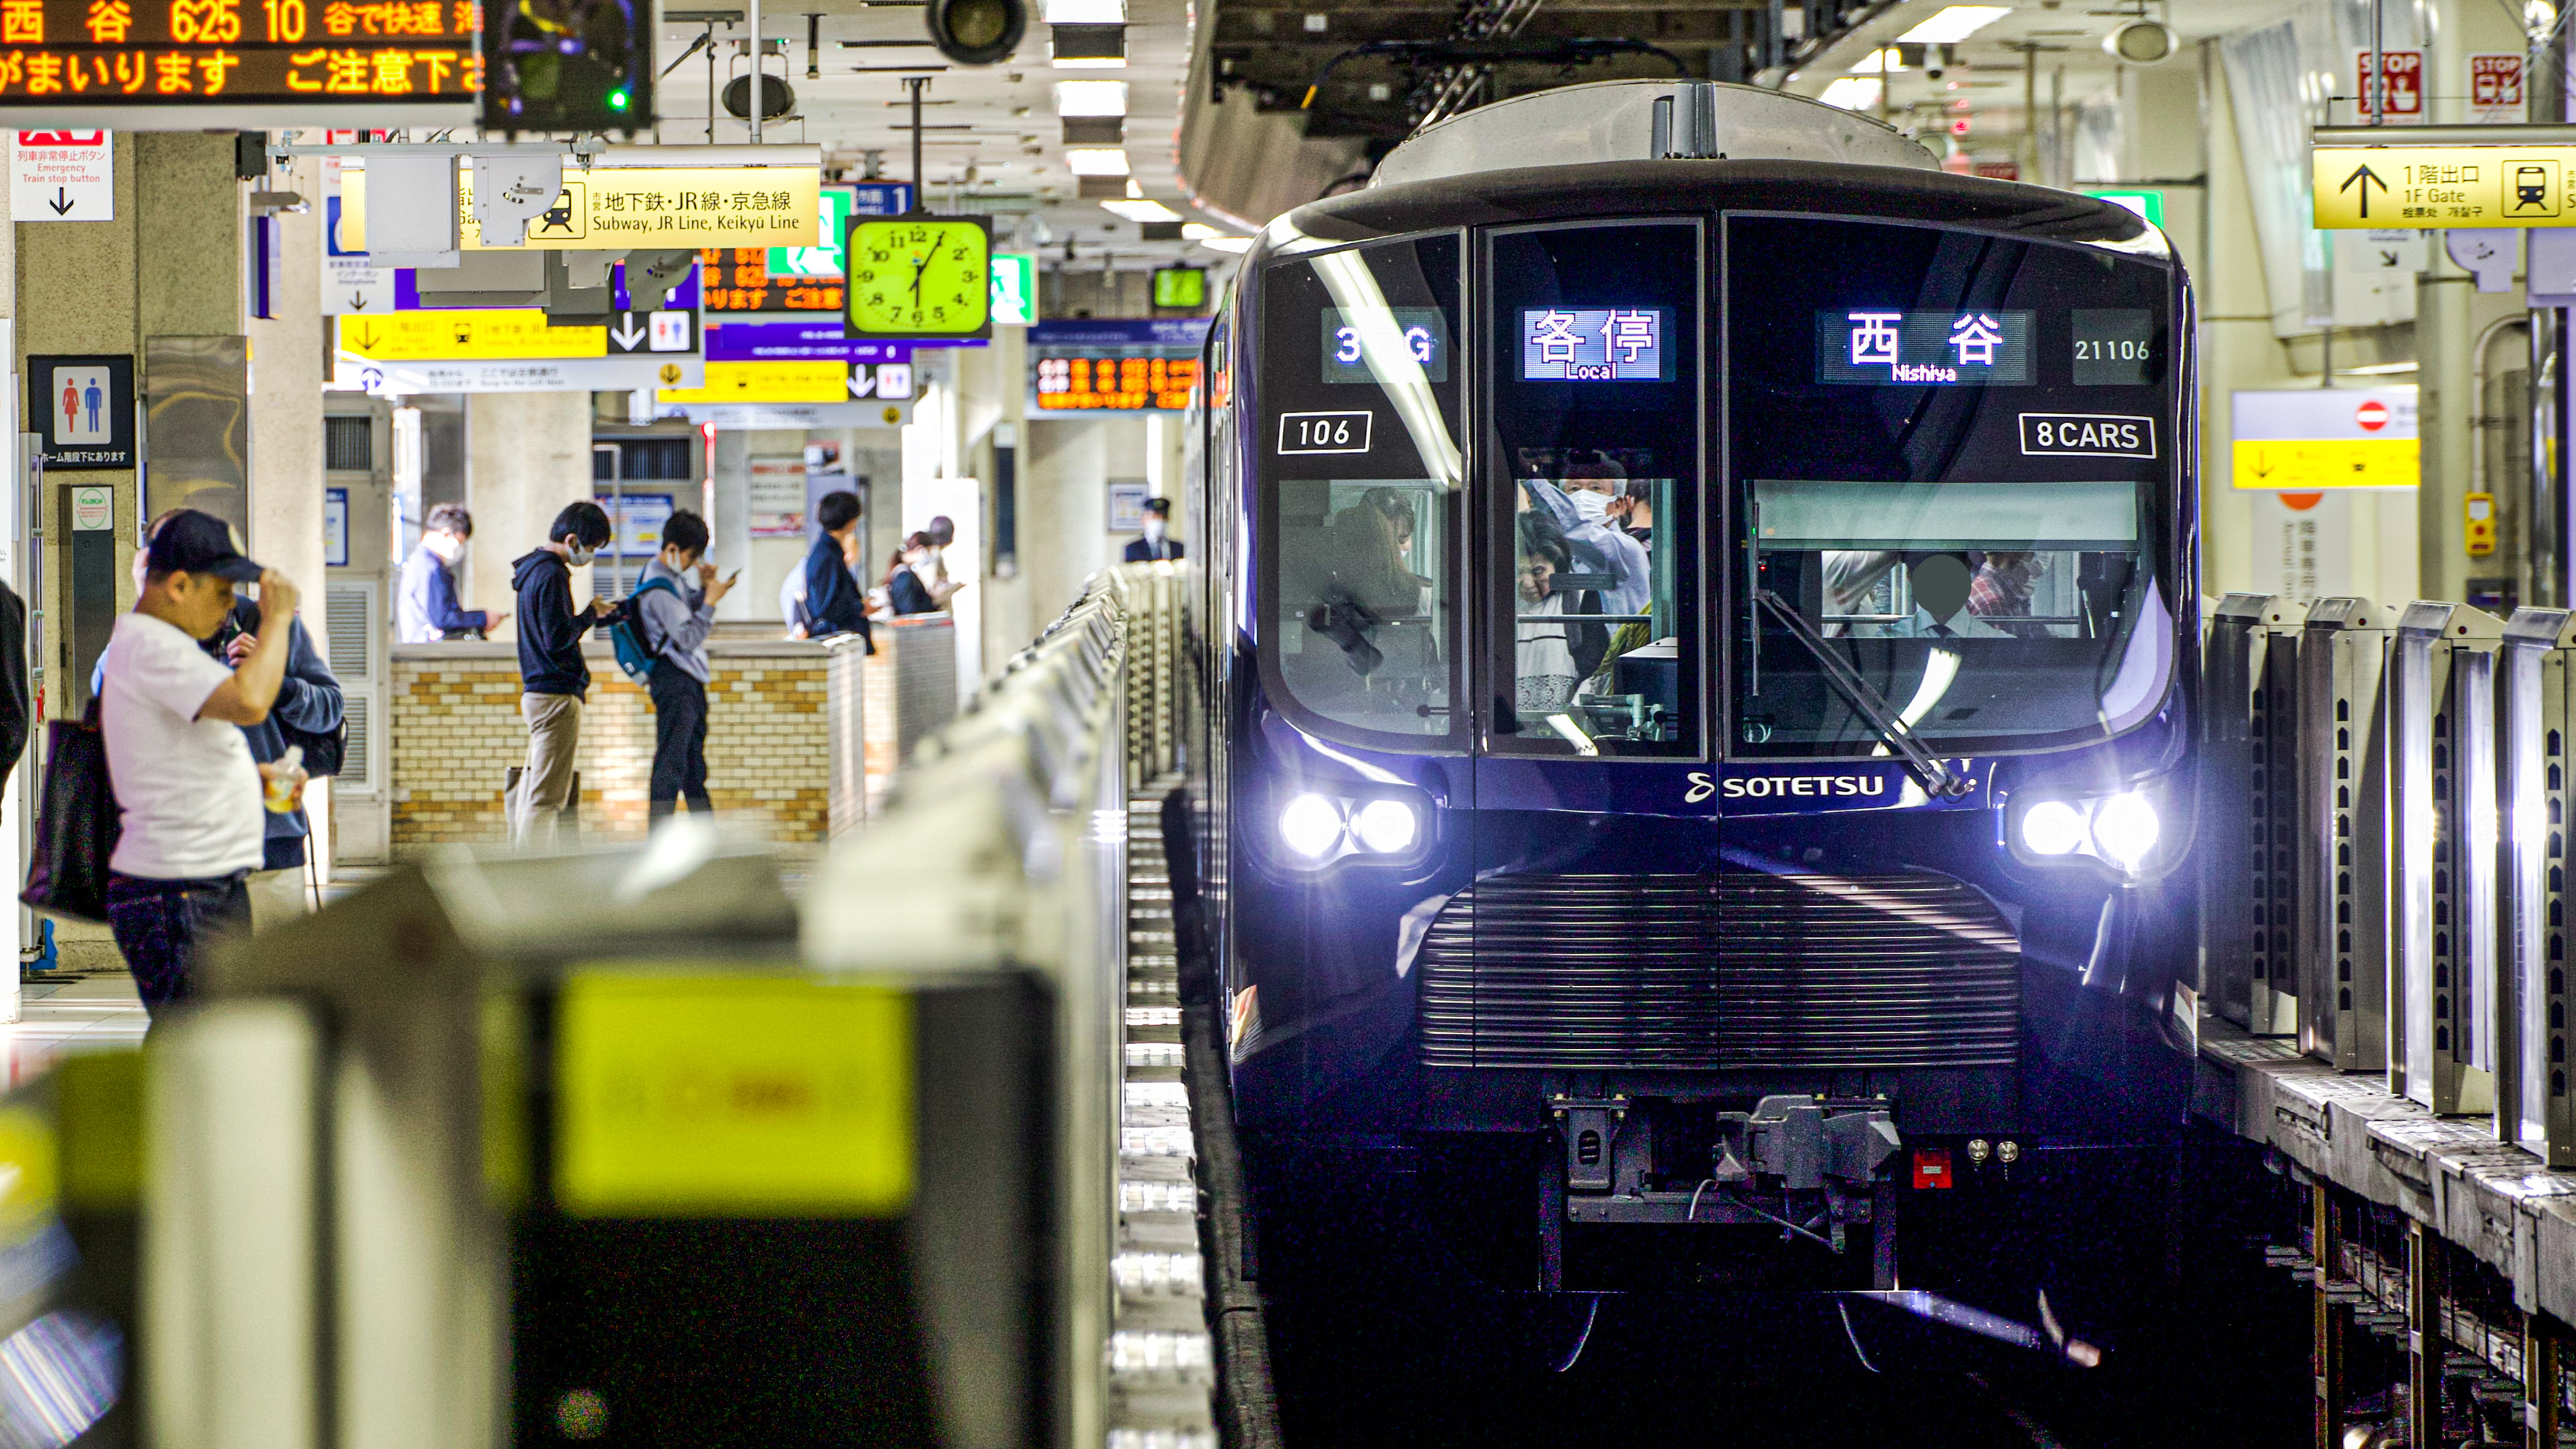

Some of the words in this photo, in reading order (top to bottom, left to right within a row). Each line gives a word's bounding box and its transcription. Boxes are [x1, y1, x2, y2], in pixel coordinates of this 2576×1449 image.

[262, 0, 306, 42] 10
[2360, 54, 2419, 73] SOP
[2474, 59, 2520, 73] STOP
[18, 150, 105, 162] 列車非常停止ボタン
[38, 163, 86, 174] Emergency
[23, 174, 45, 182] Train
[48, 174, 67, 184] stop
[70, 174, 100, 182] button
[2405, 188, 2423, 203] 1F
[2428, 188, 2465, 204] Gate
[593, 216, 652, 234] Subway,
[657, 216, 673, 230] JR
[679, 216, 712, 231] Line,
[770, 215, 799, 229] Line
[891, 236, 905, 248] 11
[910, 232, 927, 242] 12
[873, 250, 890, 262] 10
[953, 248, 964, 261] 2
[863, 270, 874, 282] 9
[962, 270, 973, 282] 3
[873, 293, 884, 305] 8
[952, 293, 964, 304] 4
[891, 306, 902, 319] 7
[912, 311, 923, 322] 6
[933, 306, 944, 319] 5
[2075, 340, 2150, 361] 21106
[1565, 362, 1617, 380] Local
[1891, 365, 1957, 383] Nishiya
[1299, 420, 1350, 445] 106
[42, 451, 126, 463] ホーム階段下にあります
[1723, 775, 1883, 798] SOTETSU
